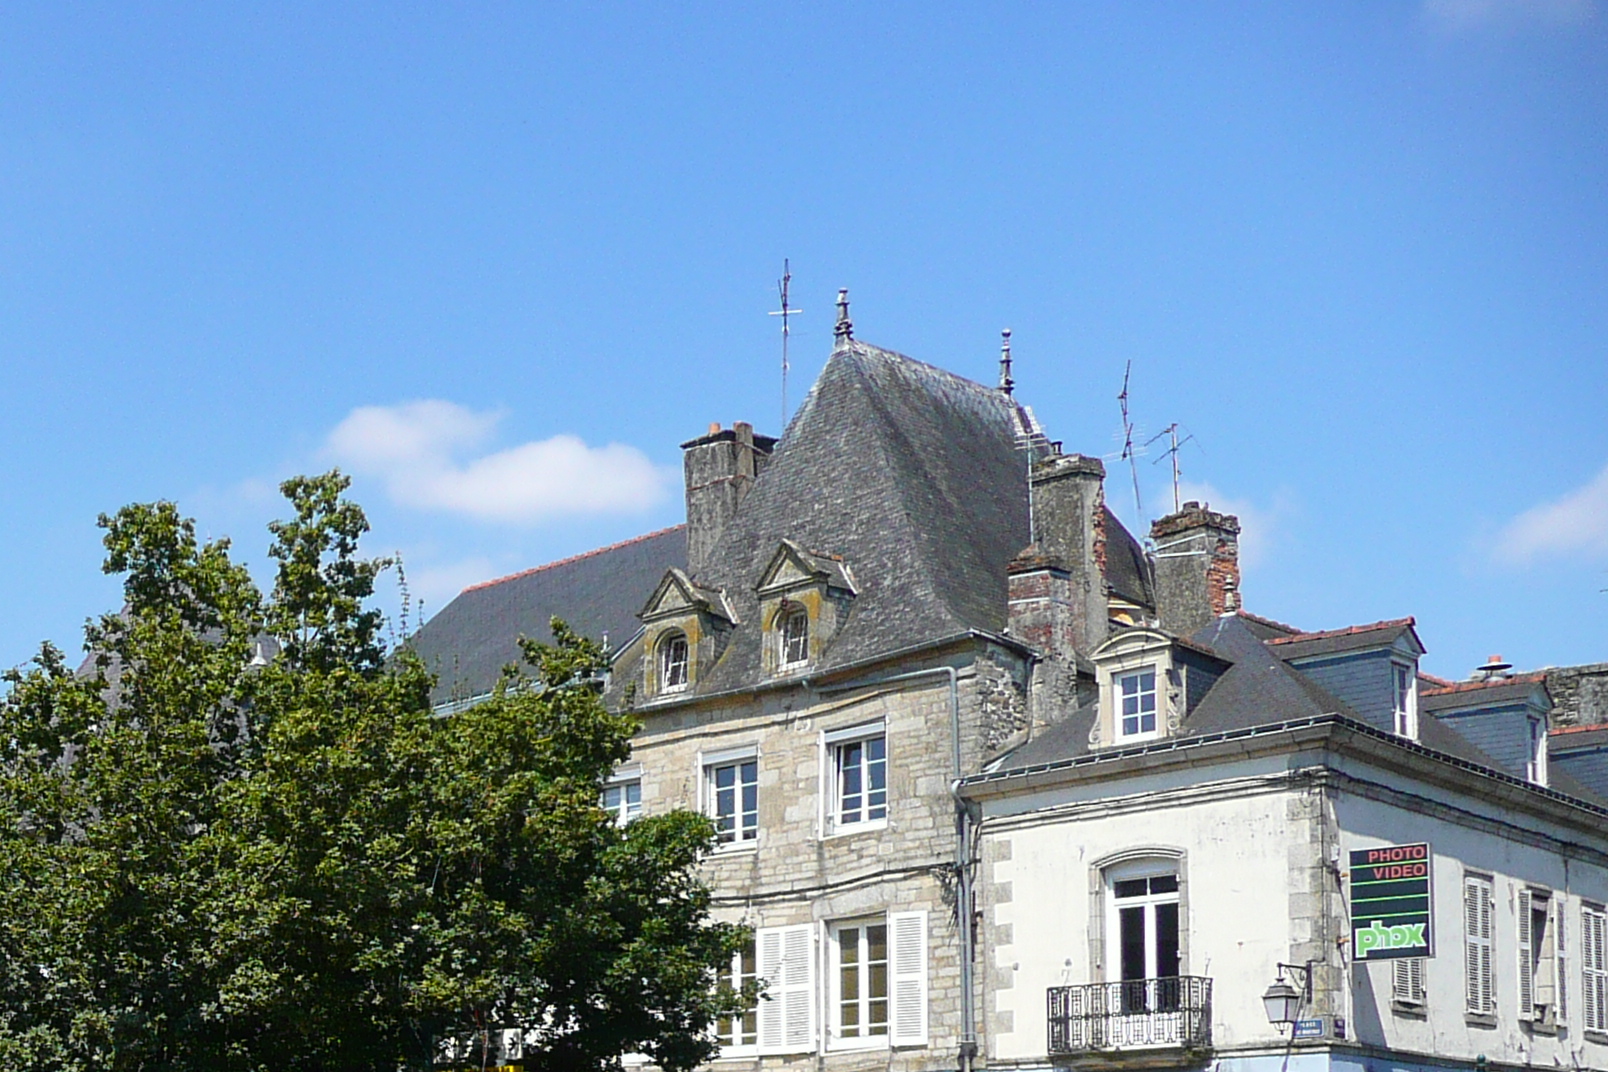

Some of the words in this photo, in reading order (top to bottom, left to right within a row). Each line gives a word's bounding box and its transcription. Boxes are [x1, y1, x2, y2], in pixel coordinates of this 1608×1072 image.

[1368, 846, 1426, 863] PHOTO
[1373, 863, 1426, 879] VIDEO
[1355, 920, 1427, 958] phox
